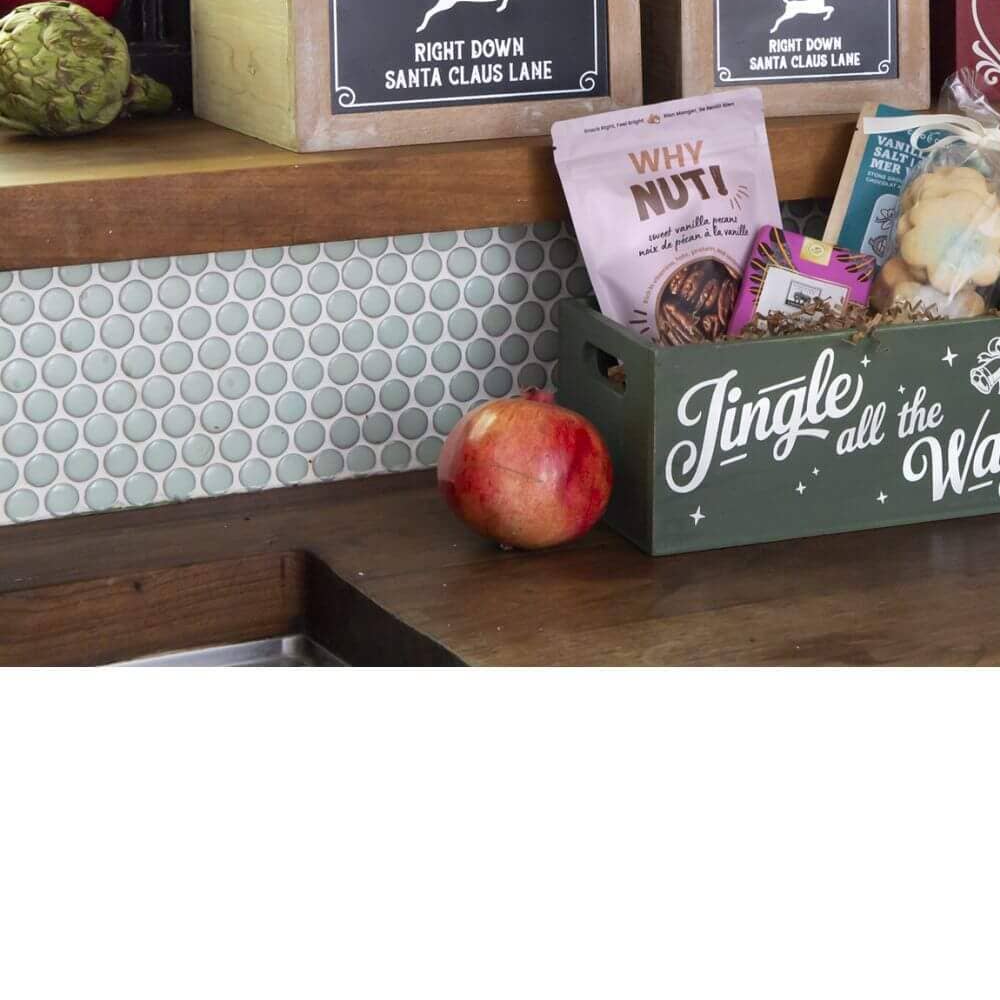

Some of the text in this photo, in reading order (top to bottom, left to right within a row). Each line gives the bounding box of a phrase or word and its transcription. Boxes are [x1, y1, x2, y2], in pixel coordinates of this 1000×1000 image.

[414, 37, 524, 62] RIGHT DOWN
[769, 37, 842, 53] RIGHT DOWN
[385, 60, 553, 90] SANTA CLAUS LANE
[749, 52, 861, 71] SANTA CLAUS LANE
[628, 140, 704, 175] WHY
[870, 158, 900, 174] MER
[873, 147, 908, 163] SALT
[630, 165, 728, 221] NUT!
[639, 225, 748, 256] noix de pécan à la vanille
[649, 215, 737, 241] sweet vanilla pecans
[666, 348, 863, 493] Jingle
[836, 386, 944, 455] all the
